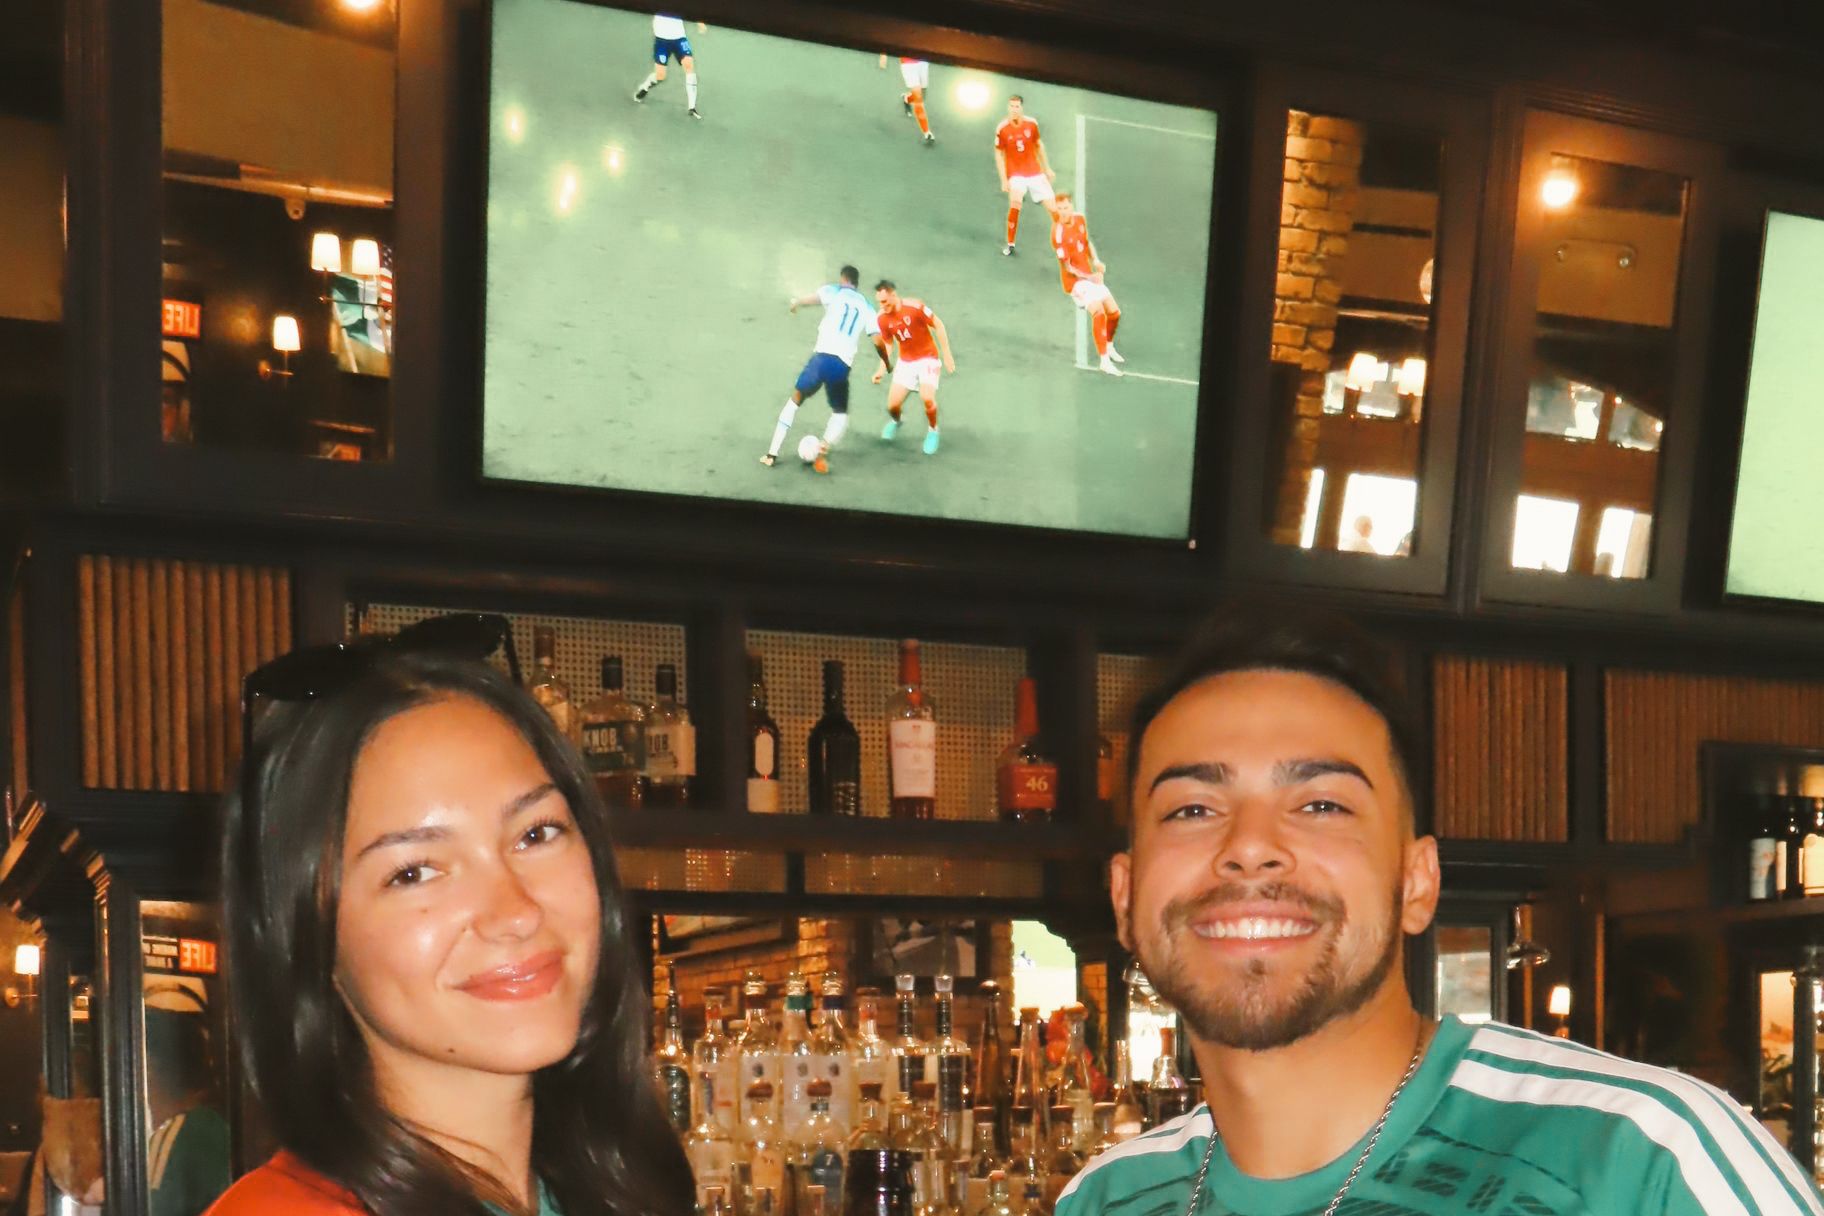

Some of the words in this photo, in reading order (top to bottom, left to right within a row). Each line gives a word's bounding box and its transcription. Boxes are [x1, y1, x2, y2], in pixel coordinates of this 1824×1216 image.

[1016, 139, 1025, 152] 5
[840, 303, 859, 336] 11
[897, 327, 912, 341] 14
[583, 727, 617, 748] KNOB
[1026, 776, 1049, 792] 46
[824, 1154, 834, 1166] 7
